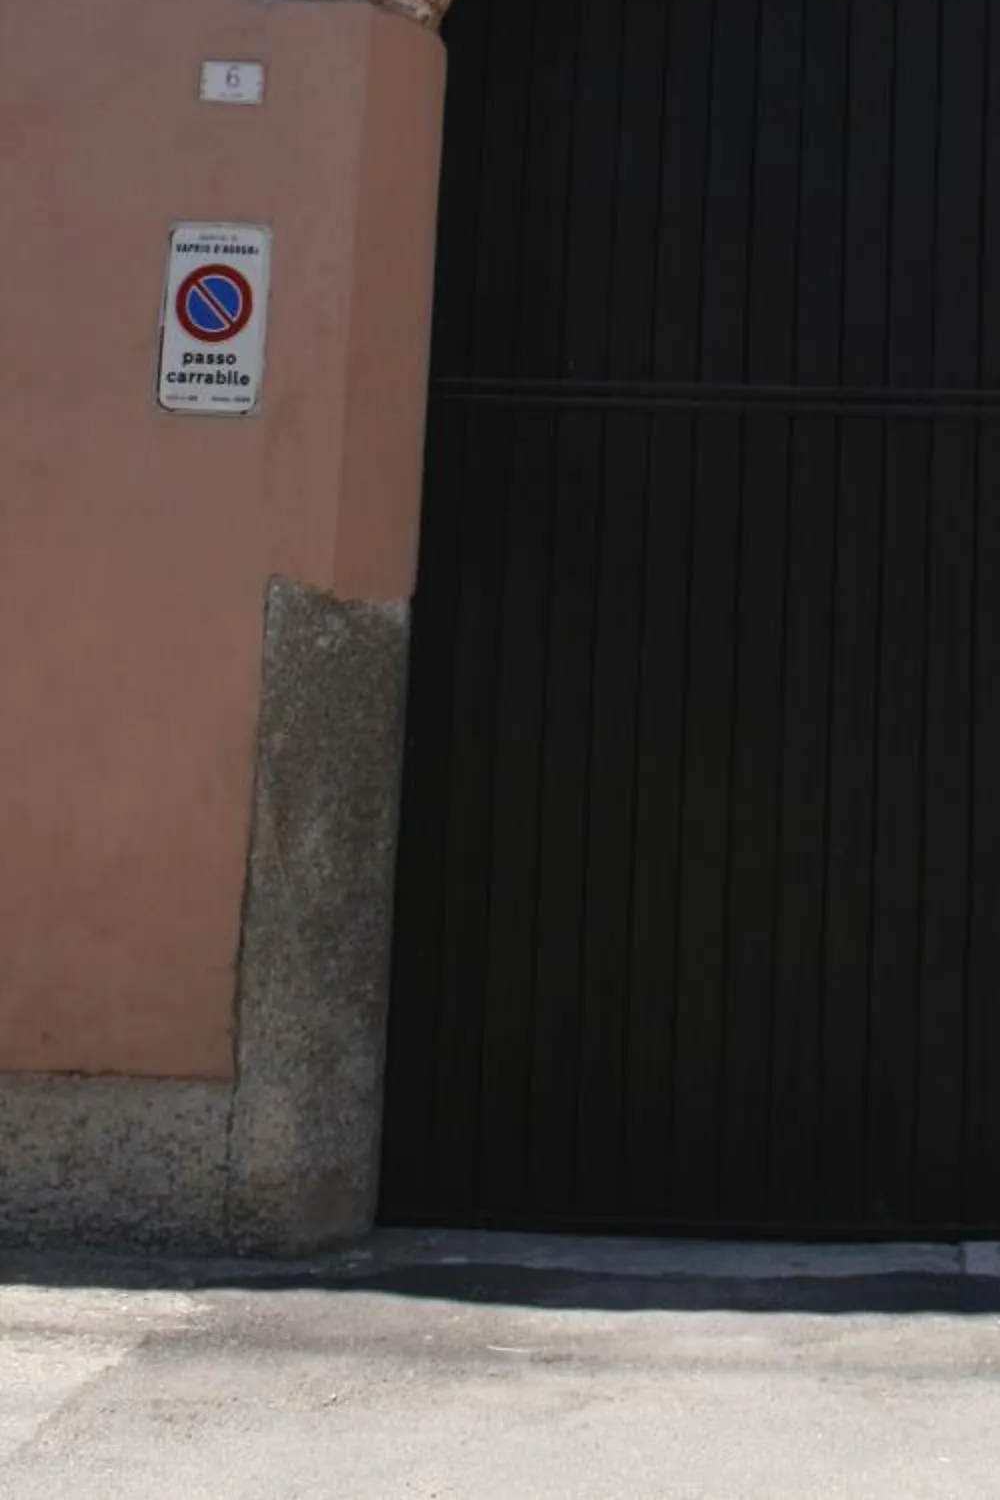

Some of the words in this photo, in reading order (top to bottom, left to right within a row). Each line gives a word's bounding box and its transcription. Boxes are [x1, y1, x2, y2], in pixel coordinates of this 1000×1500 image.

[225, 65, 241, 90] 6
[183, 351, 237, 367] passo
[166, 369, 251, 386] carrabile
